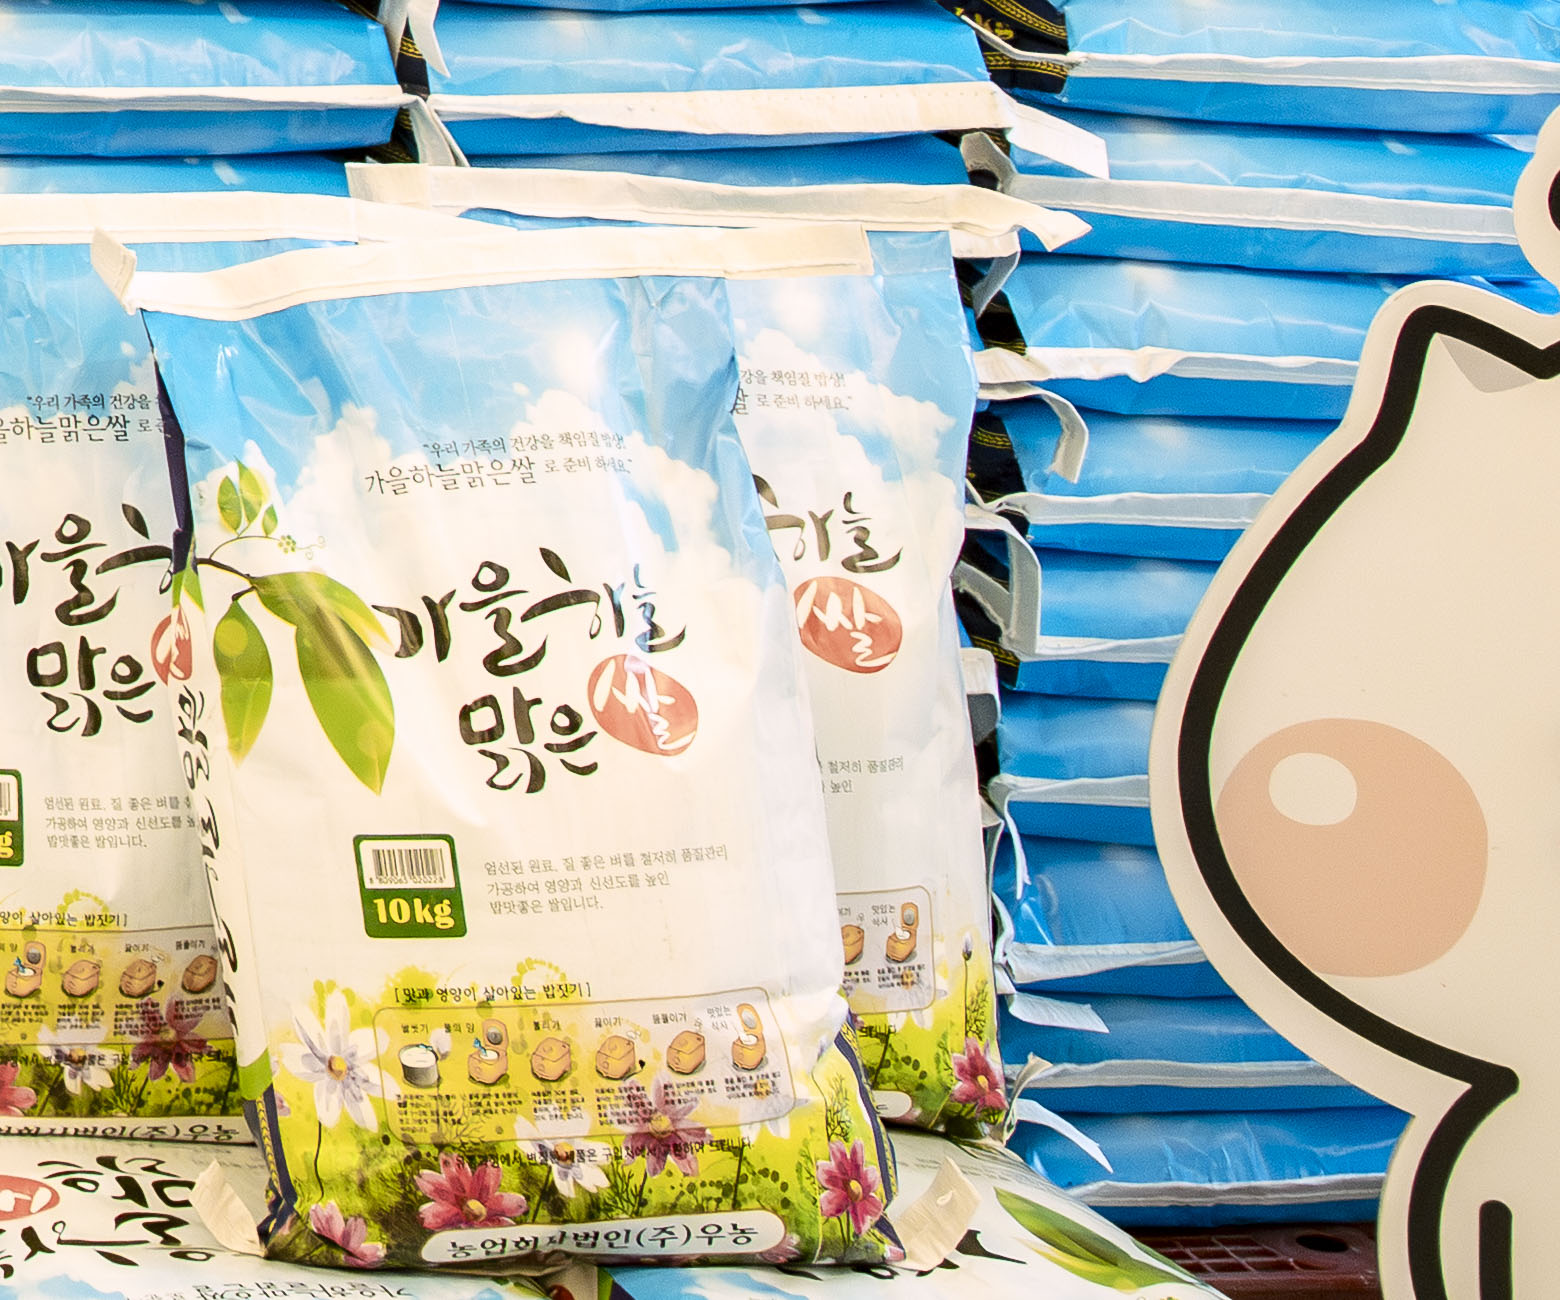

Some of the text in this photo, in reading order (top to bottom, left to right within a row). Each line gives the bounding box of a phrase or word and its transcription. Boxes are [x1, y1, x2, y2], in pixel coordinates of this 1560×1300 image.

[64, 395, 105, 410] 가족의
[110, 394, 150, 410] 건강을
[372, 547, 686, 677] 가을하늘
[27, 636, 156, 738] 맑은
[459, 686, 598, 794] 맑은
[373, 898, 455, 929] 10kg
